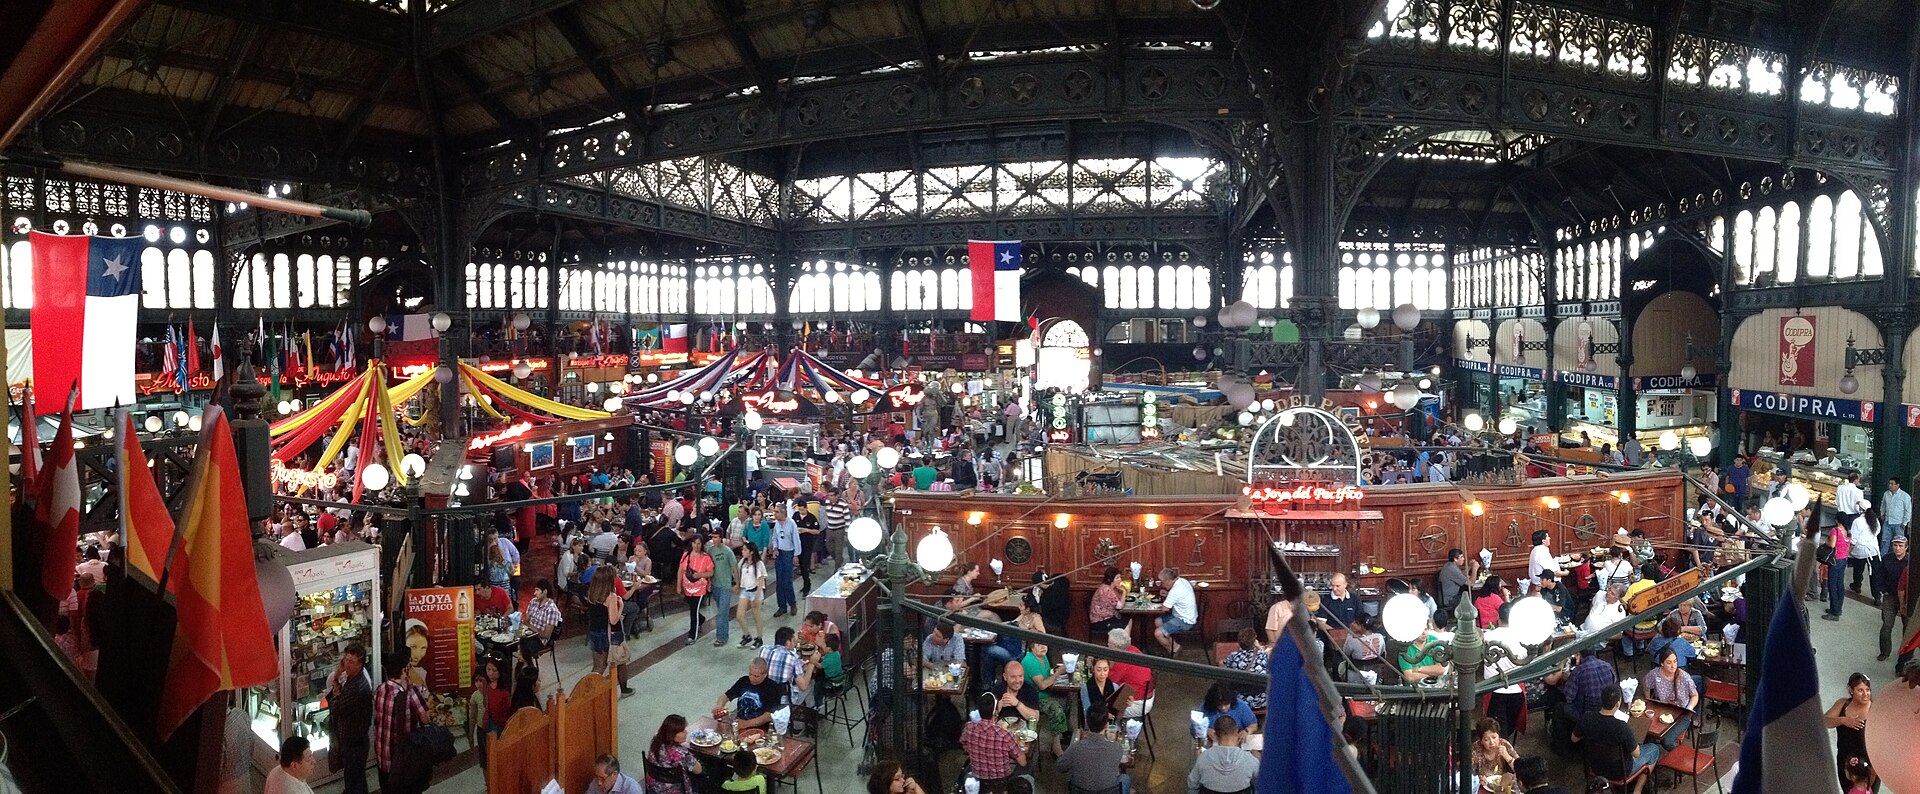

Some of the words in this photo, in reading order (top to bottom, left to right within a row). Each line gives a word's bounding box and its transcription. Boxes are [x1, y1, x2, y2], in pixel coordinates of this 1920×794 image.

[1785, 327, 1813, 337] CODIPRA
[1458, 360, 1482, 371] CODIPRA
[1500, 365, 1532, 378] CODIPRA
[1563, 373, 1605, 387] CODIPRA
[1274, 394, 1316, 412] DEL
[1753, 393, 1838, 417] CODIPRA
[418, 594, 453, 605] JOYA
[409, 603, 453, 613] PACIFICO
